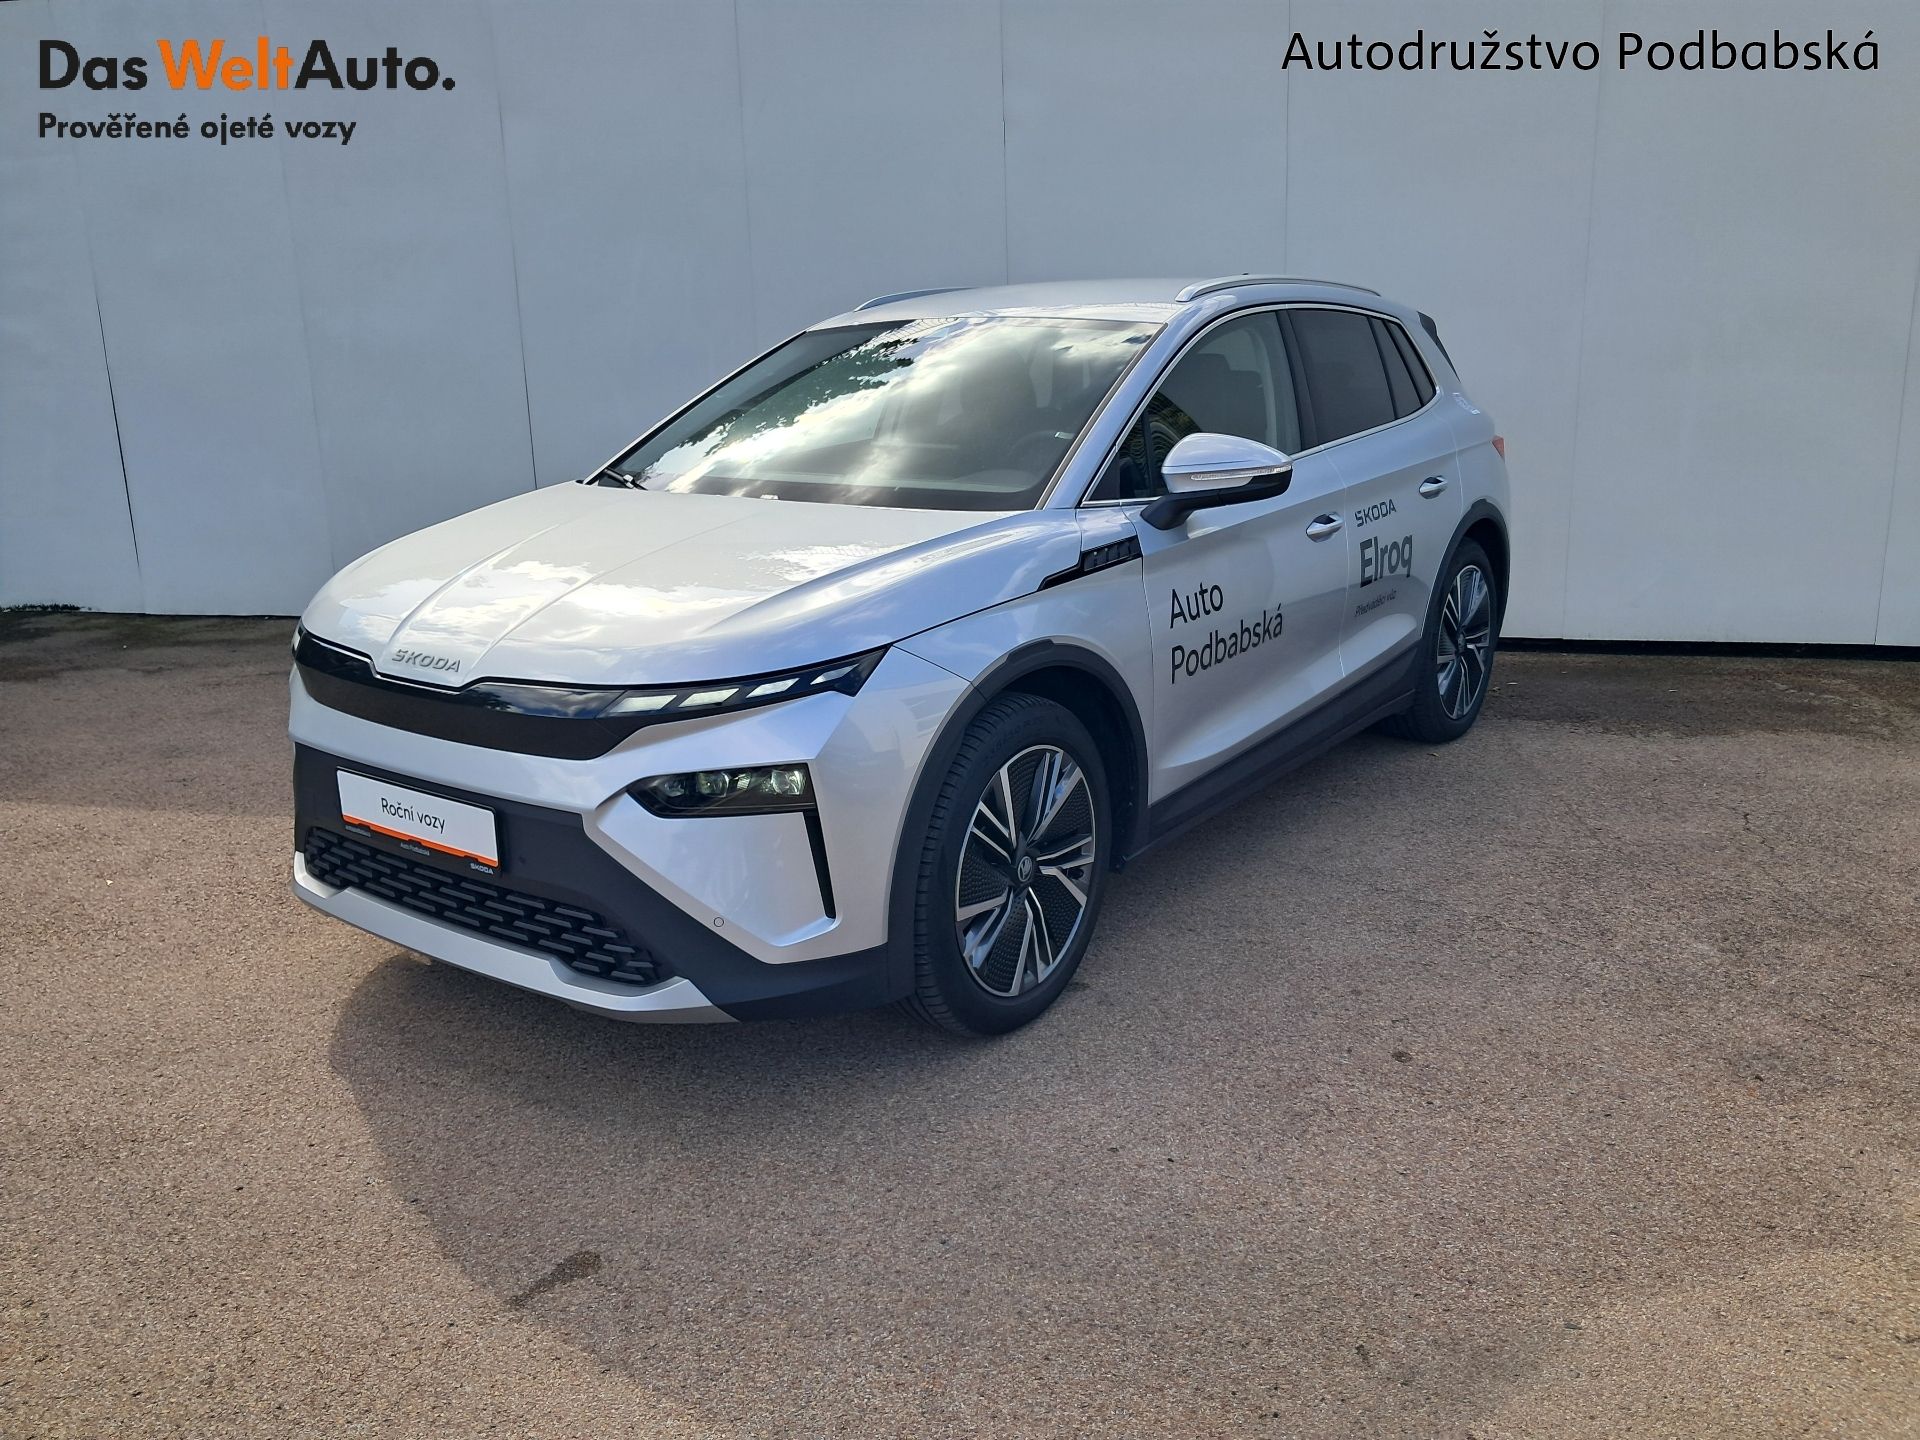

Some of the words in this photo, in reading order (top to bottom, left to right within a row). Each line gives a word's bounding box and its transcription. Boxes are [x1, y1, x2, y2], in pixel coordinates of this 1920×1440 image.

[1359, 535, 1413, 588] Elroq
[1170, 582, 1224, 629] Auto
[1171, 602, 1283, 684] Podbabská
[381, 797, 415, 822] Roční
[416, 811, 446, 834] vozy
